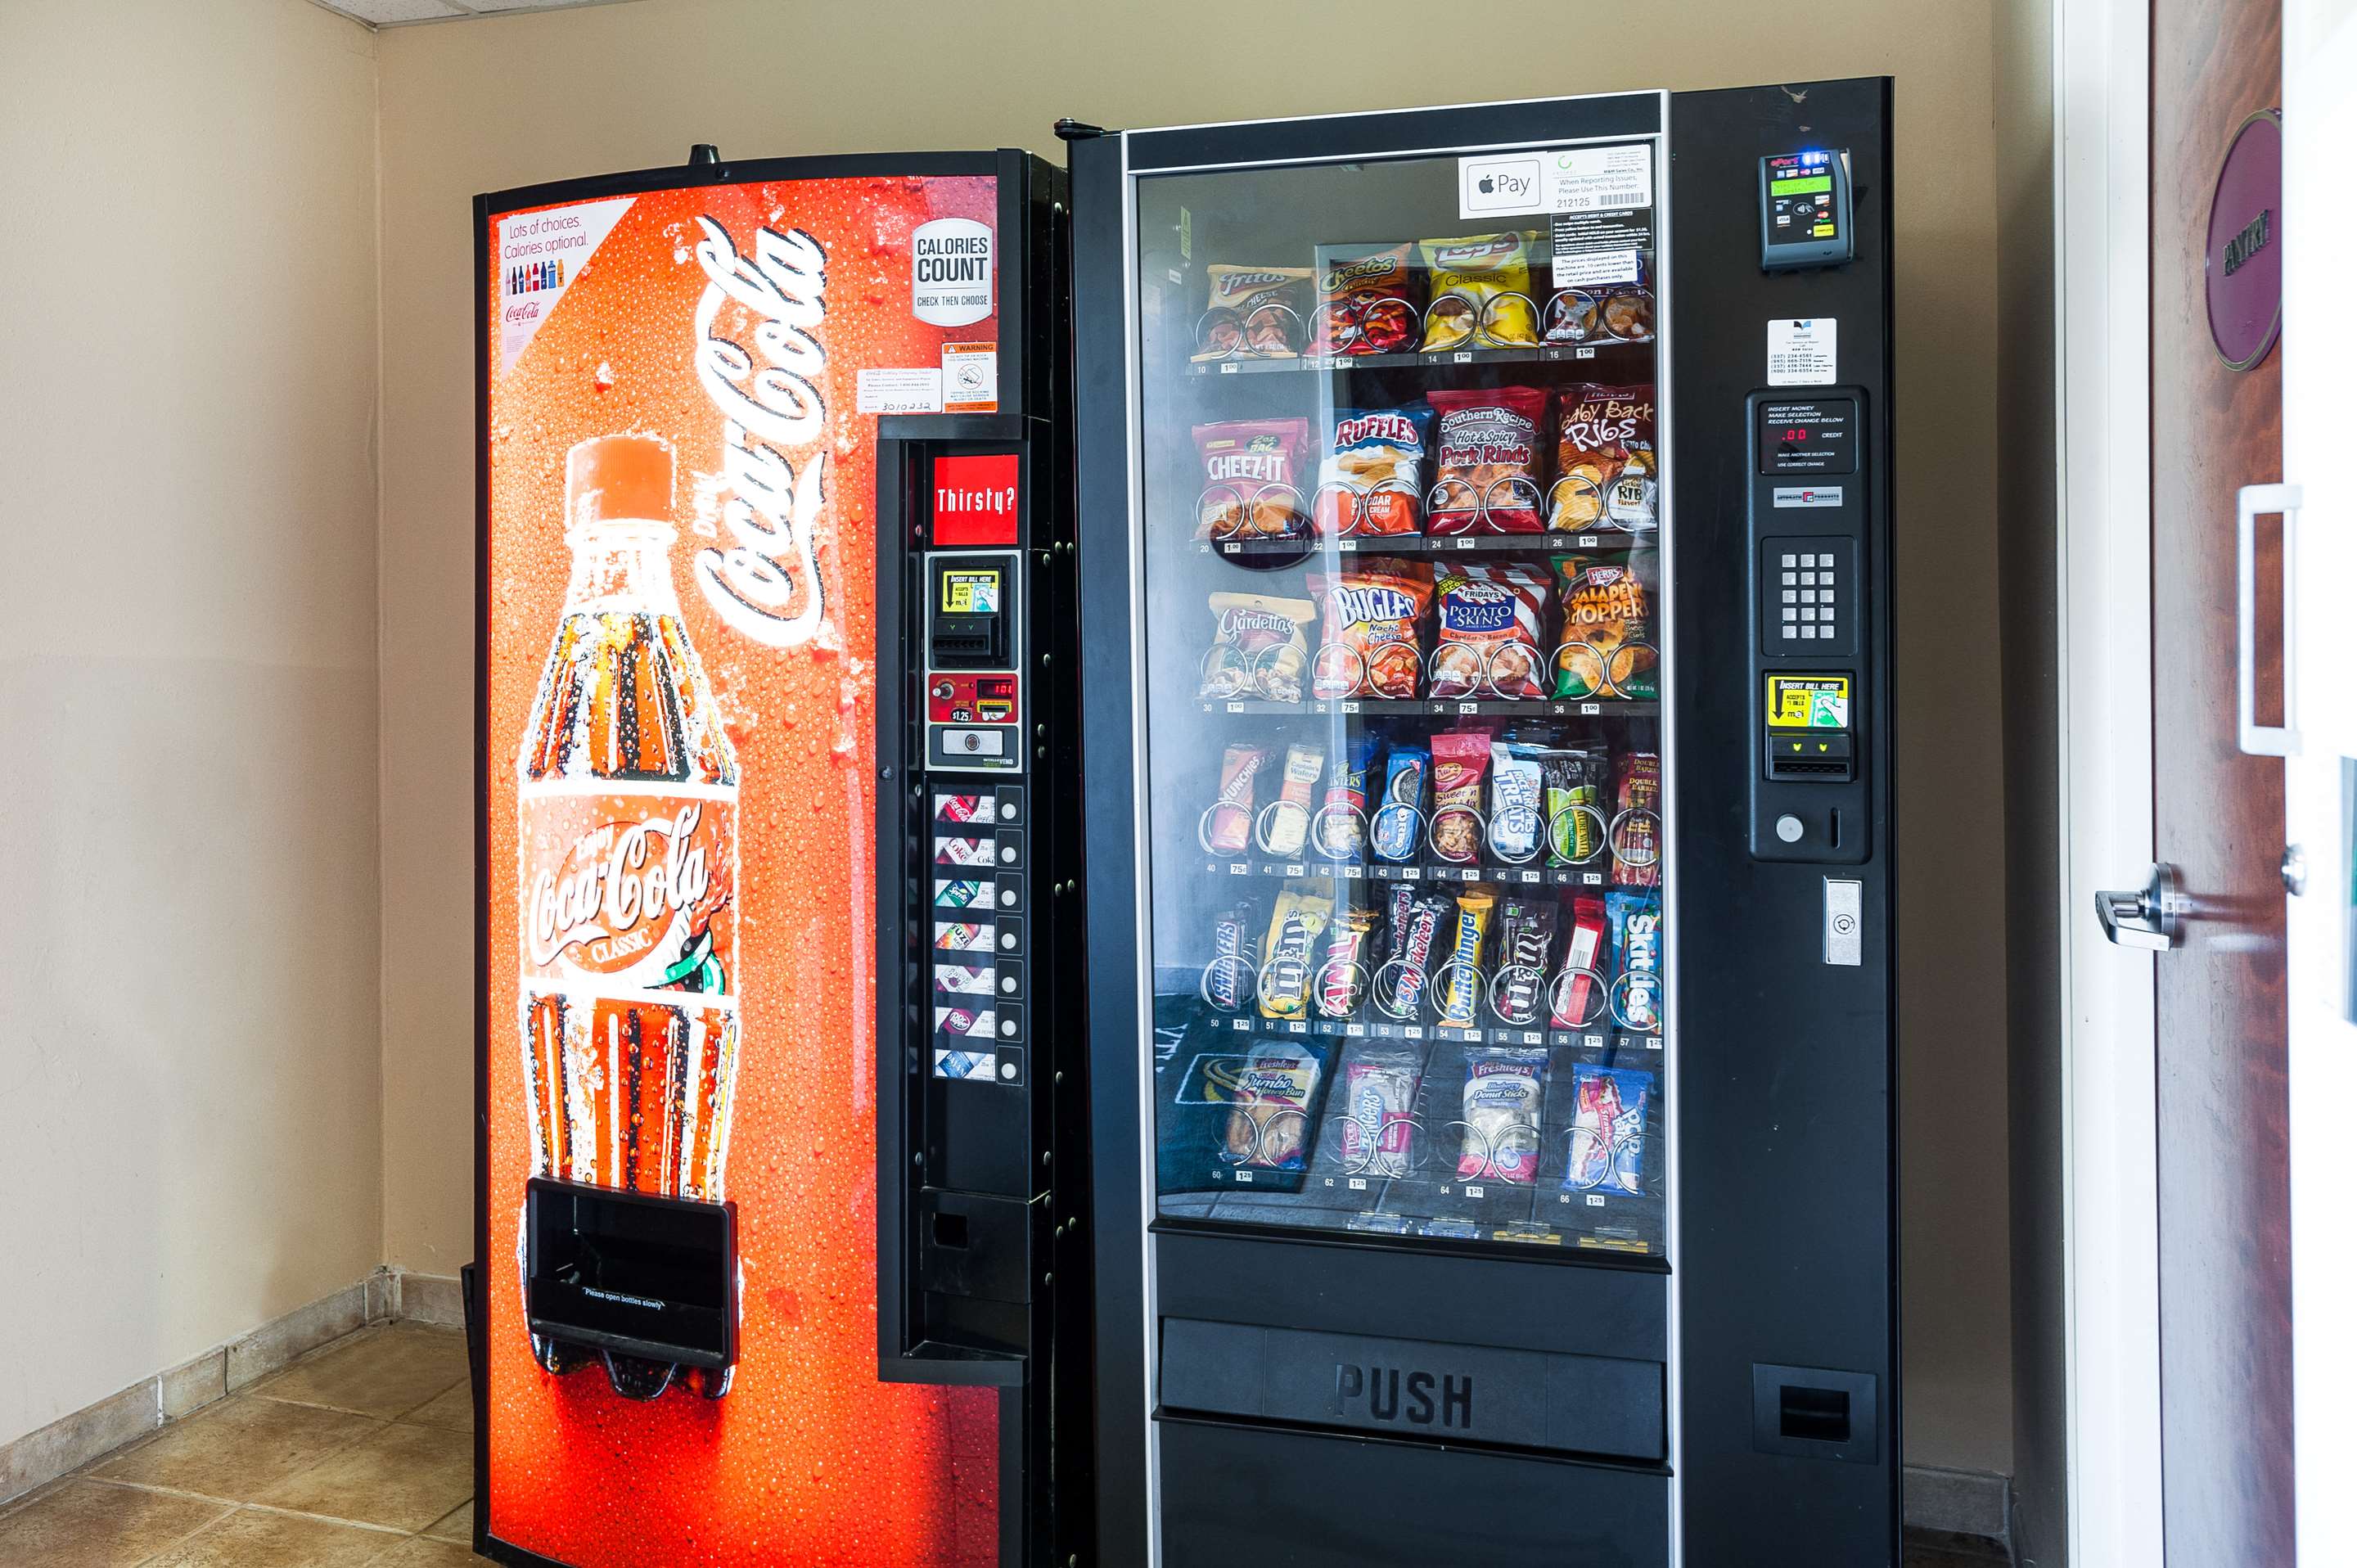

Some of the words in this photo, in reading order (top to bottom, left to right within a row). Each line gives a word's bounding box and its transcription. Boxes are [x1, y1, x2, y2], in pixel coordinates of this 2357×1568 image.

[1498, 174, 1530, 196] Pay
[1581, 177, 1614, 185] Reporting
[1557, 197, 1590, 208] 212125
[510, 225, 527, 239] Lots
[530, 219, 540, 235] of
[542, 216, 582, 232] choices.
[504, 242, 543, 259] Calories
[545, 231, 588, 255] optional.
[917, 237, 987, 255] CALORIES
[917, 258, 987, 282] COUNT
[1320, 256, 1398, 295] Cheetos
[1446, 274, 1506, 286] Classic
[917, 296, 939, 306] CHECK
[943, 295, 958, 306] THEN
[962, 295, 987, 305] CHOOSE
[1428, 355, 1437, 363] 14
[1549, 351, 1559, 359] 16
[1606, 401, 1654, 422] Back
[1440, 410, 1493, 433] Southern
[1494, 408, 1532, 429] Recipe
[1335, 415, 1418, 448] RUFFLES
[1565, 419, 1637, 452] Ribs
[1249, 444, 1273, 453] BAG
[1440, 445, 1480, 466] Pork
[1482, 444, 1530, 464] Rinds
[1207, 455, 1285, 482] CHEEZ-IT
[1618, 486, 1642, 500] RIB
[938, 487, 1015, 515] Thirsty?
[1432, 540, 1441, 548] 24
[1332, 587, 1414, 629] BUGLES
[1450, 606, 1512, 617] POTATO
[1571, 597, 1643, 624] POPPER
[1220, 609, 1295, 643] Gardetto's
[1457, 616, 1503, 627] SKINS
[1368, 624, 1399, 633] Nacho
[1368, 633, 1401, 645] Cheese
[1449, 632, 1478, 641] Cheddar
[1779, 681, 1804, 689] INSERT
[1434, 704, 1443, 713] 34
[1554, 705, 1565, 714] 36
[953, 711, 969, 721] $1.25
[1219, 755, 1260, 801] MUNCHIES
[1512, 770, 1530, 794] RICE
[1629, 777, 1657, 786] DOUBLE
[1437, 791, 1466, 800] Sweet
[1494, 771, 1524, 833] TREATS
[1378, 869, 1387, 877] 43
[1437, 870, 1446, 878] 44
[1496, 872, 1506, 880] 45
[1557, 874, 1567, 883] 46
[592, 926, 652, 963] CLASSIC
[1215, 921, 1237, 1004] SNICKERS
[1449, 909, 1480, 1019] Butterfinger
[1626, 914, 1655, 1023] Skittles
[1439, 1030, 1448, 1039] 54
[1498, 1032, 1507, 1041] 55
[1558, 1035, 1568, 1044] 56
[1620, 1038, 1629, 1047] 57
[1242, 1074, 1292, 1090] Jumbo
[1487, 1082, 1520, 1090] Blueberry
[1256, 1087, 1285, 1097] Honey
[1286, 1088, 1305, 1097] Bun
[1474, 1090, 1502, 1099] Donut
[1502, 1088, 1528, 1098] Sticks
[1324, 1178, 1334, 1187] 62
[1560, 1195, 1570, 1203] 66
[622, 1295, 641, 1304] bottles
[1335, 1363, 1472, 1429] PUSH
